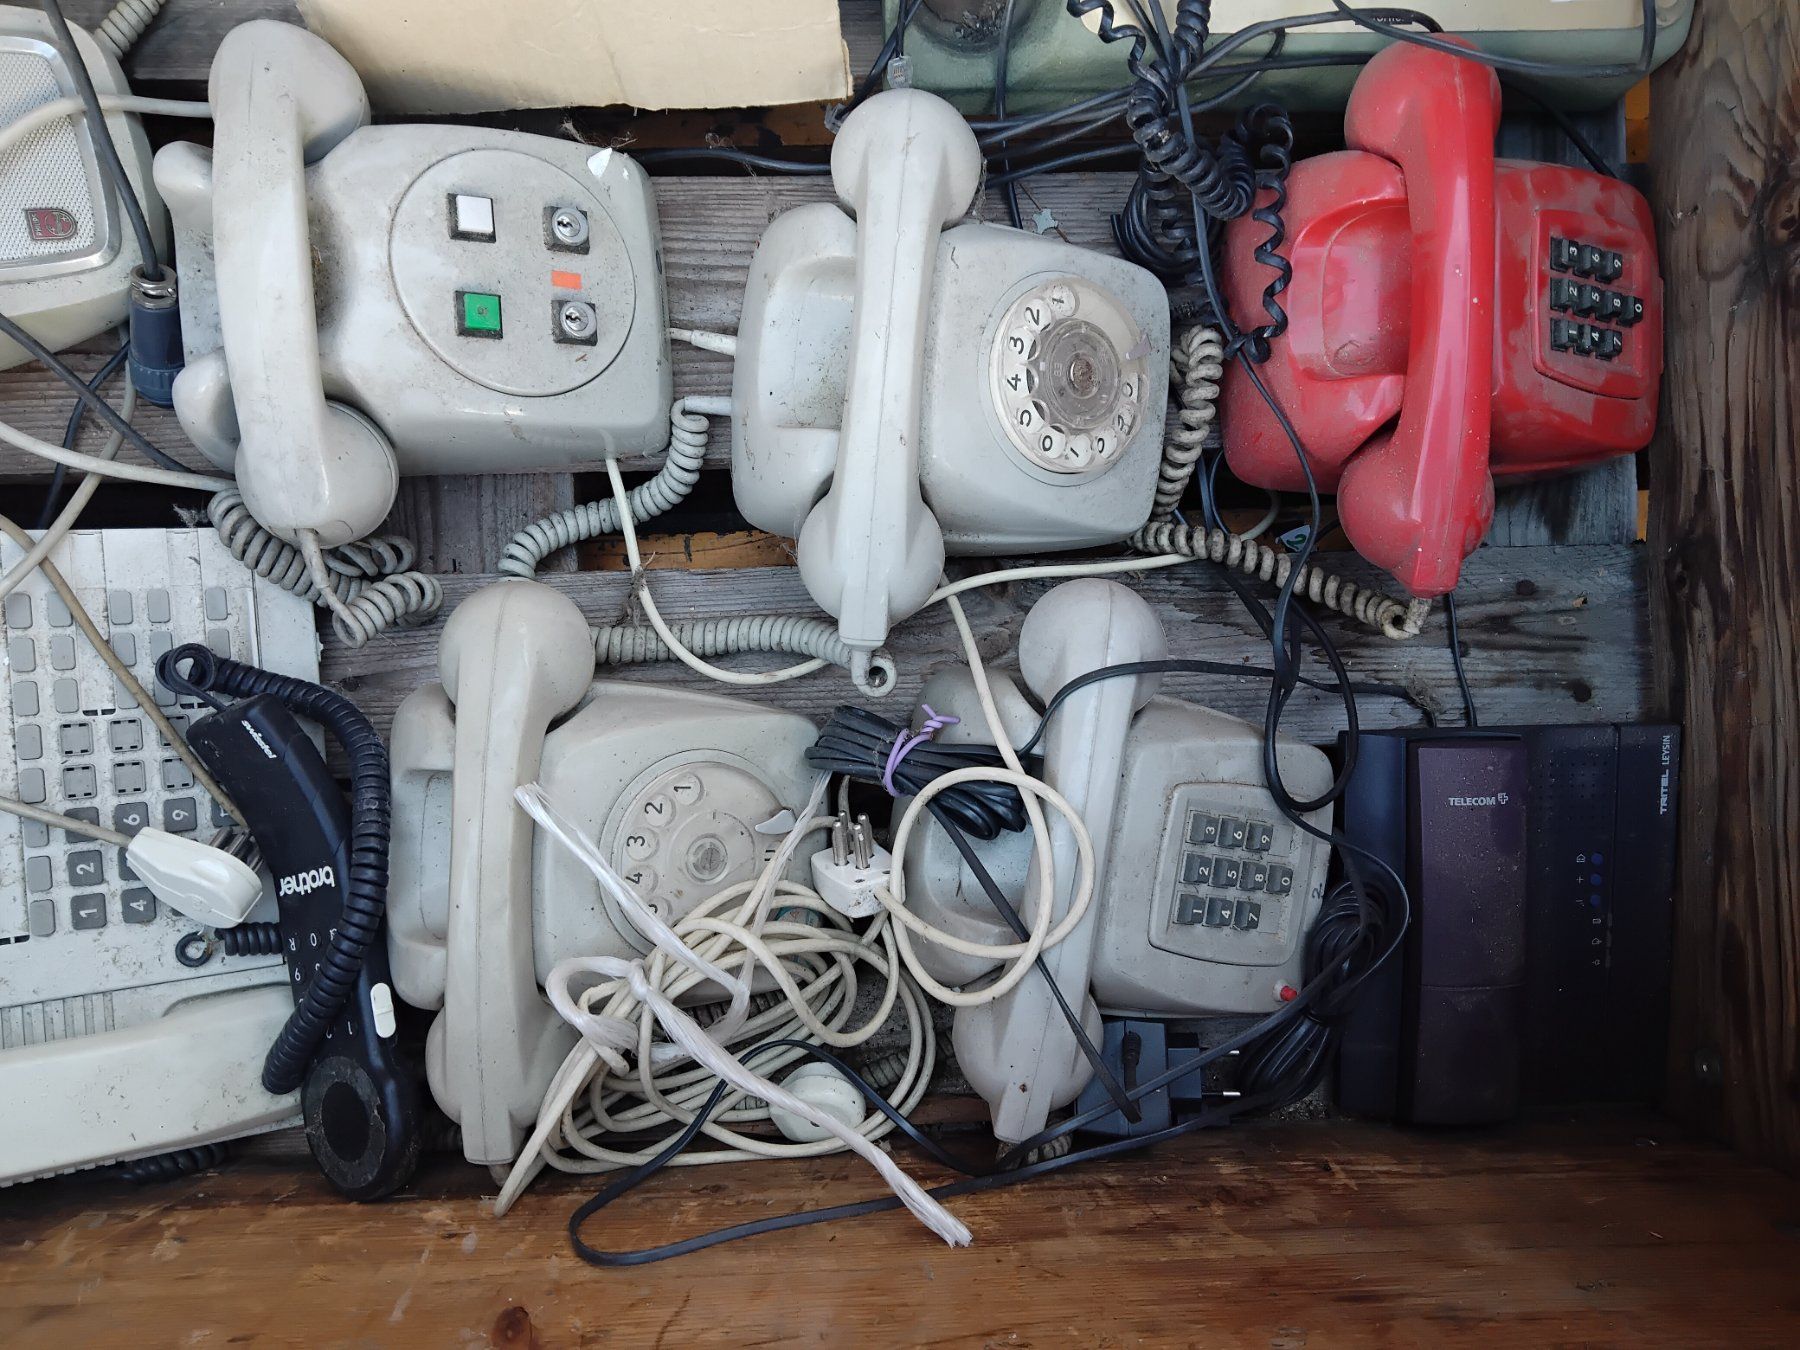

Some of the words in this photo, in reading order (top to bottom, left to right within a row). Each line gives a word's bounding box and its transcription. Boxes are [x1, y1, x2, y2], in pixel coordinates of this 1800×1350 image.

[1569, 246, 1578, 255] 3
[1591, 254, 1600, 262] 6
[1613, 259, 1621, 267] 9
[1569, 287, 1577, 296] 2
[1591, 292, 1599, 302] 5
[1613, 298, 1621, 307] 8
[1634, 303, 1643, 312] 0
[1025, 306, 1040, 326] 2
[1591, 331, 1599, 341] 4
[1613, 337, 1621, 346] 7
[1009, 336, 1025, 354] 3
[1006, 373, 1021, 391] 4
[1662, 735, 1671, 765] LEYSIN
[1660, 769, 1669, 815] TRITEL
[644, 801, 663, 814] 2
[1448, 797, 1496, 806] TELECOM
[123, 813, 140, 826] 6
[172, 809, 189, 821] 9
[626, 835, 646, 847] 3
[1199, 866, 1209, 875] 2
[1205, 826, 1215, 835] 3
[76, 862, 95, 875] 2
[1221, 909, 1231, 919] 4
[1227, 870, 1237, 879] 5
[1233, 830, 1243, 840] 6
[279, 866, 336, 897] brother
[625, 872, 643, 885] 4
[1248, 912, 1258, 922] 7
[1254, 873, 1264, 882] 8
[1261, 835, 1271, 843] 9
[1281, 877, 1291, 886] 0
[130, 899, 147, 912] 4
[79, 908, 98, 918] 1
[289, 937, 297, 951] R
